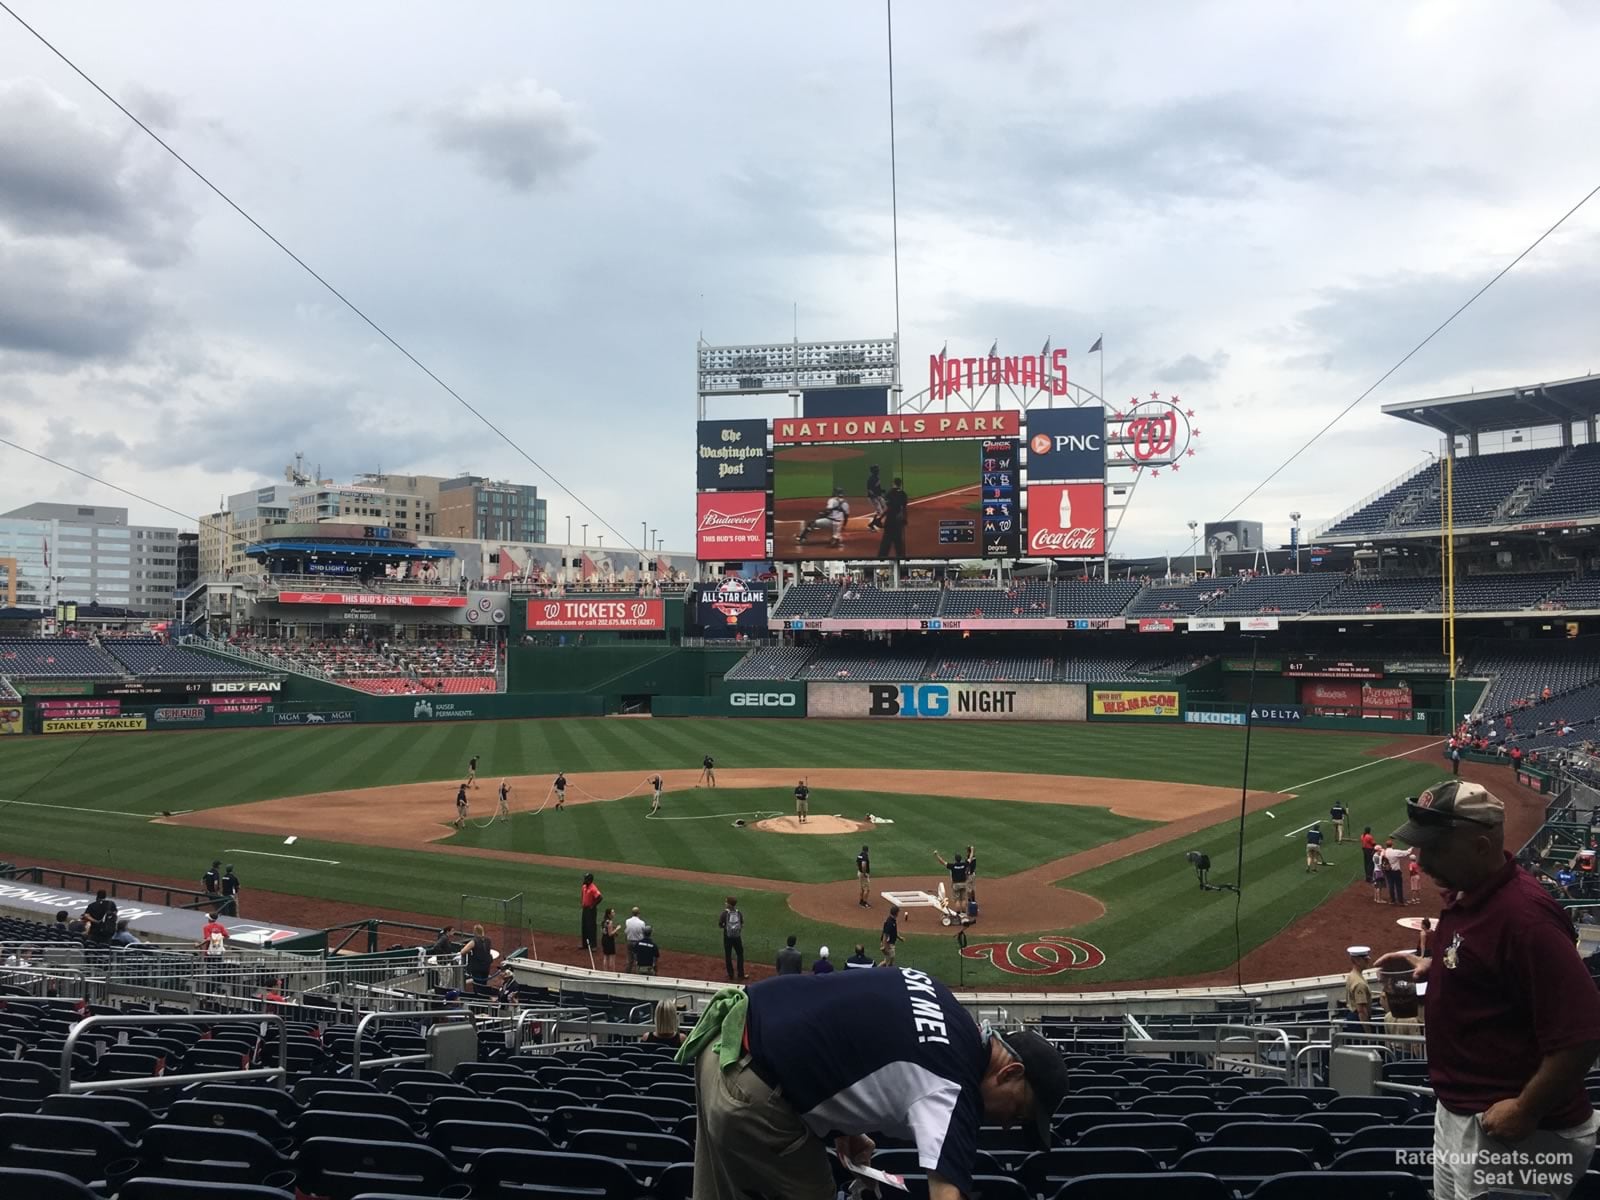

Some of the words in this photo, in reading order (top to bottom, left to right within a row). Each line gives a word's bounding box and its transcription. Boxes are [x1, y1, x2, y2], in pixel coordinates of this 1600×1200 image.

[929, 349, 1067, 400] NATIONALS
[782, 419, 926, 437] NATIONALS
[939, 416, 1005, 432] PARK
[721, 429, 742, 442] The
[1054, 434, 1100, 451] PNC
[699, 444, 763, 460] Washington
[719, 463, 744, 478] Post
[703, 513, 757, 526] Budweiser
[1031, 527, 1100, 550] Coca-Cola
[341, 595, 358, 604] THIS
[360, 595, 381, 604] BUD'S
[383, 596, 397, 605] FOR
[702, 592, 717, 603] ALL
[718, 592, 740, 603] STAR
[741, 592, 764, 602] GAME
[564, 602, 626, 618] TICKETS
[805, 621, 822, 629] NIGHT
[942, 621, 961, 629] NIGHT
[1090, 620, 1110, 629] NIGHT
[249, 681, 281, 692] FAN
[730, 693, 796, 707] GEICO
[957, 690, 1017, 713] NIGHT
[278, 713, 300, 721] MGM
[331, 712, 352, 720] MGM
[1202, 713, 1241, 725] KOCH
[1261, 709, 1301, 720] DELTA
[47, 721, 93, 731] STANLEY
[97, 720, 143, 729] STANLEY
[910, 996, 951, 1045] ME!
